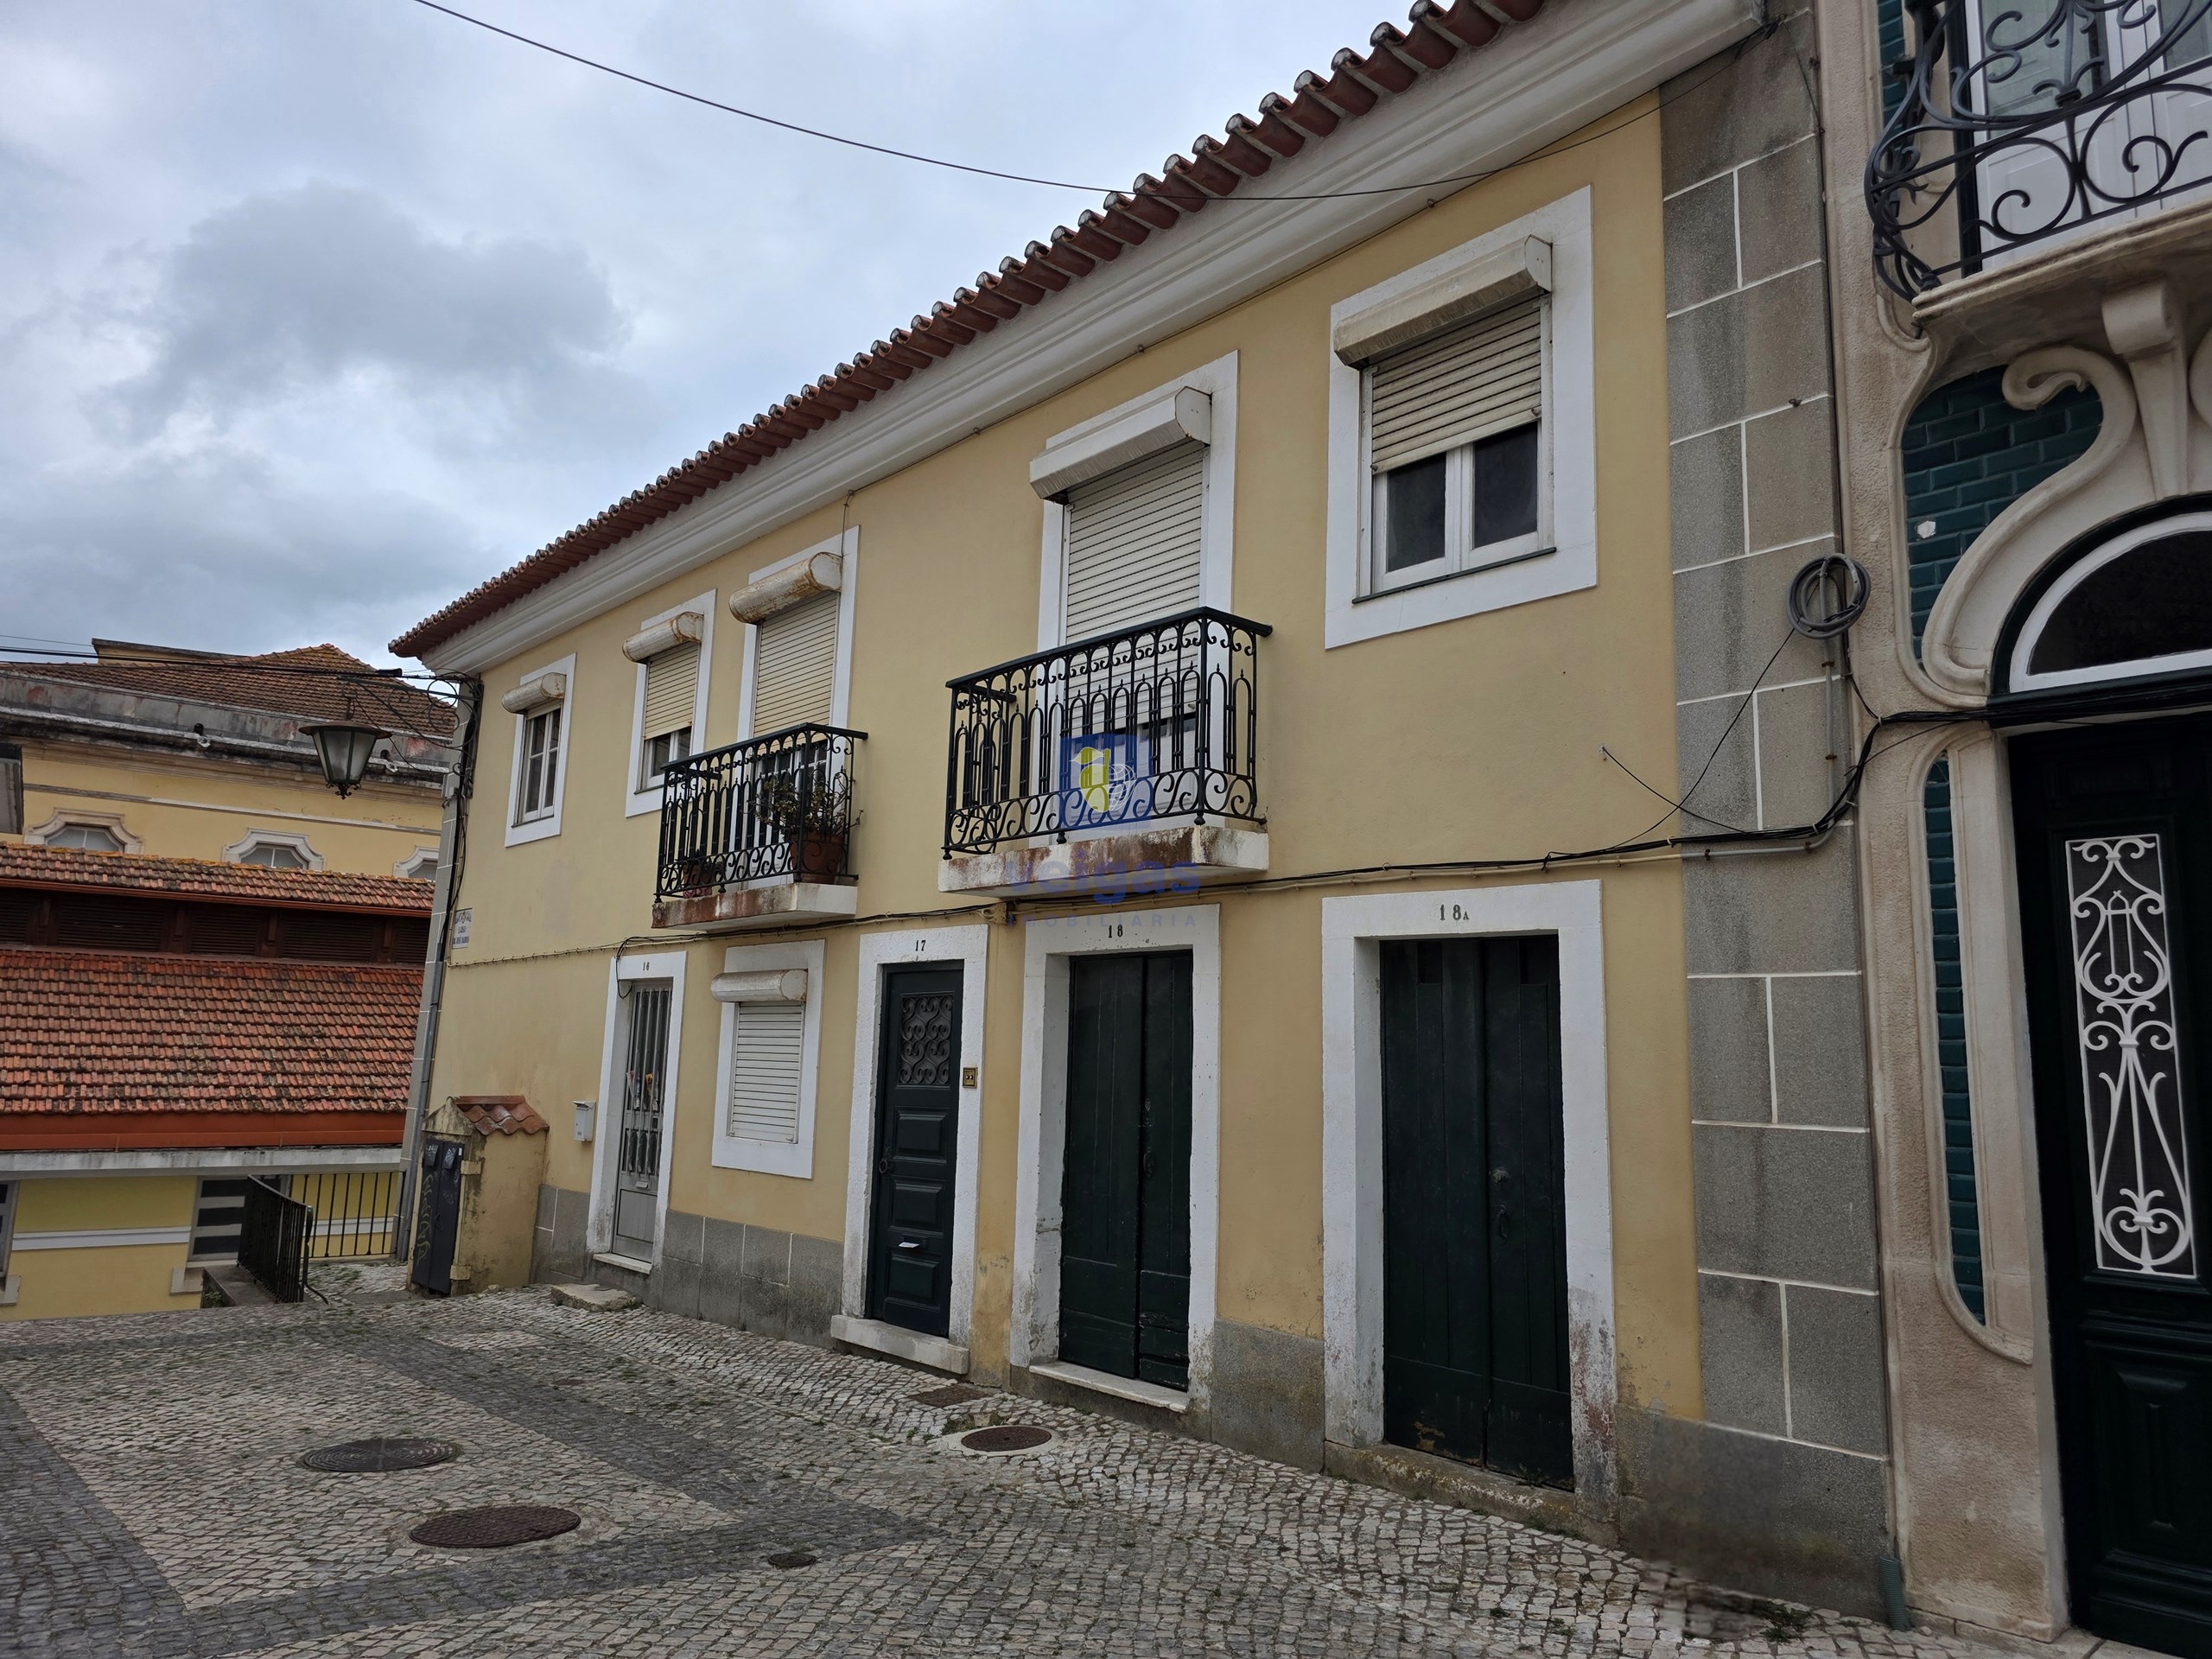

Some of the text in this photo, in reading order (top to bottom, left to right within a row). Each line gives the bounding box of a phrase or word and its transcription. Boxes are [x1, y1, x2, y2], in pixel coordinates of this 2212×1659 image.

[1440, 904, 1470, 921] 18A
[1108, 924, 1123, 938] 18
[915, 939, 926, 951] 17
[642, 961, 650, 971] 16
